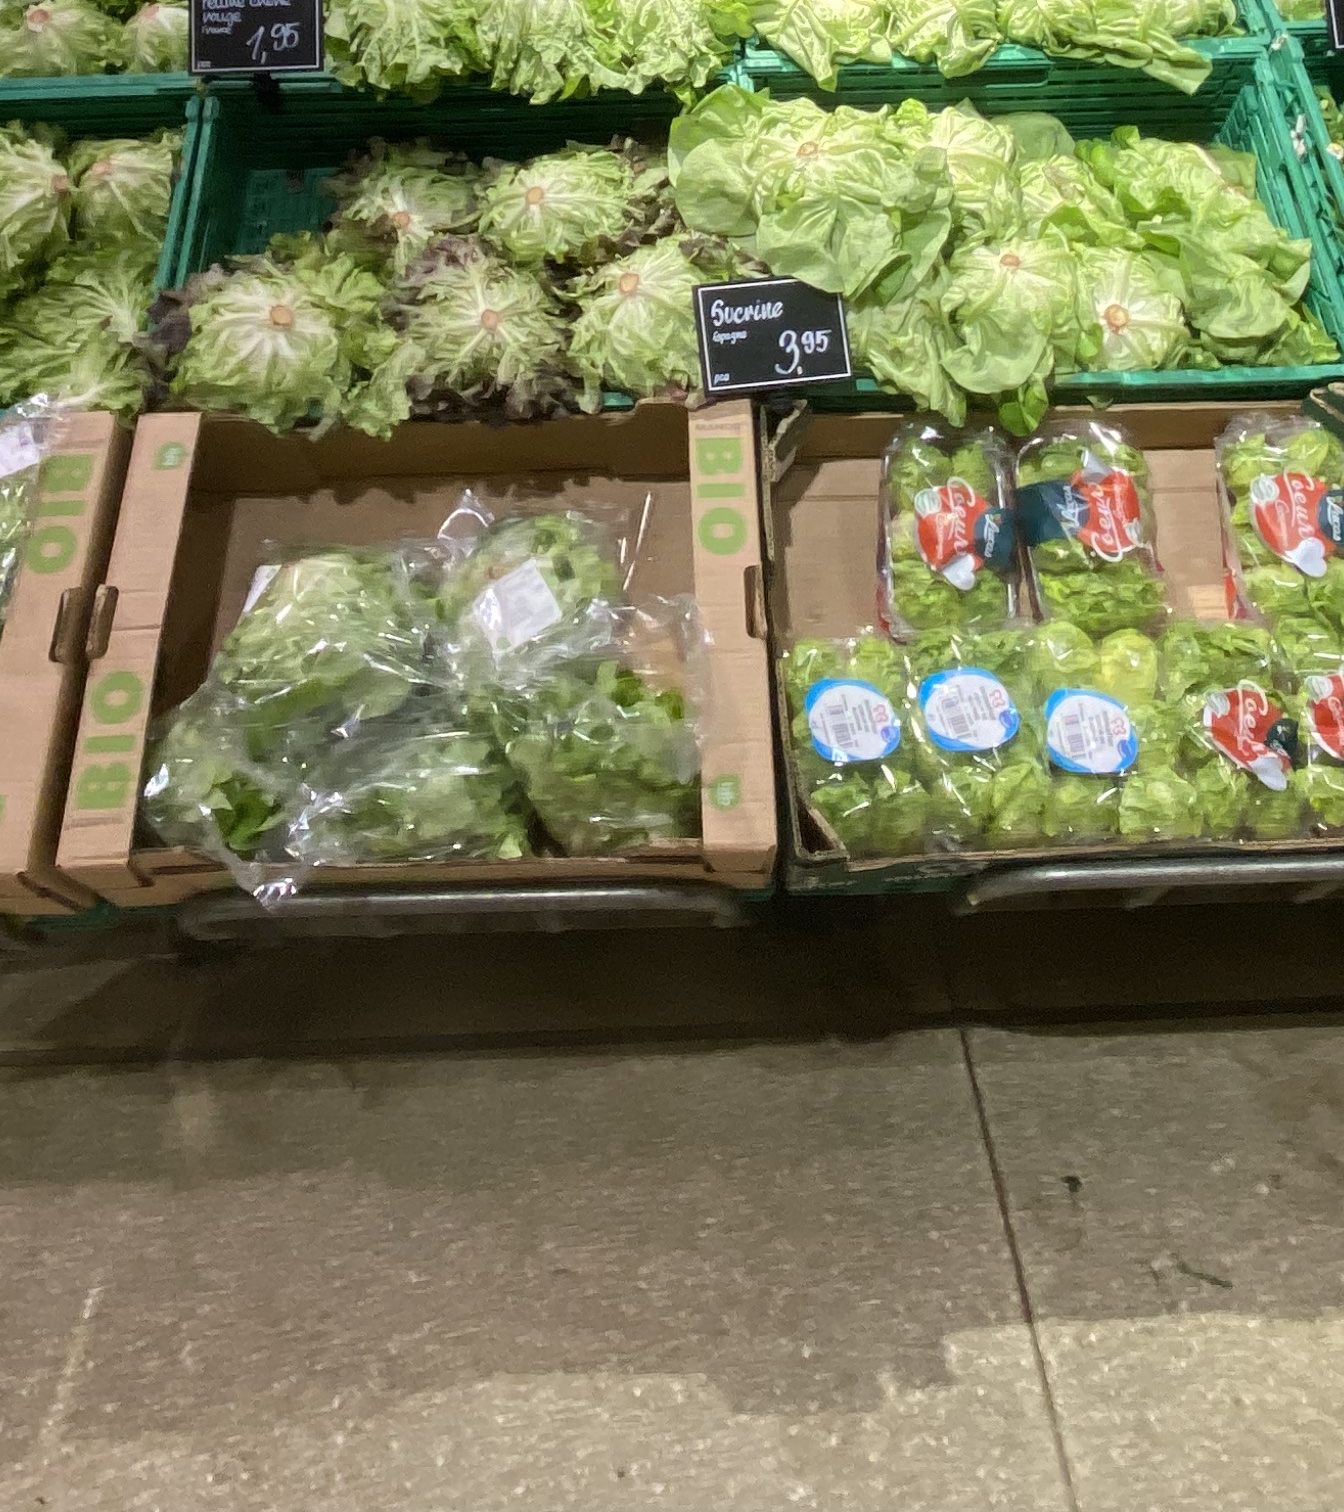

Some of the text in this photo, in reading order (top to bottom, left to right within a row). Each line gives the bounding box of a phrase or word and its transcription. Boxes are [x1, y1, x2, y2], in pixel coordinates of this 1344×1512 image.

[710, 298, 784, 327] Sucrine
[25, 454, 96, 575] BIO
[694, 437, 748, 556] BIO
[73, 671, 145, 810] BIO
